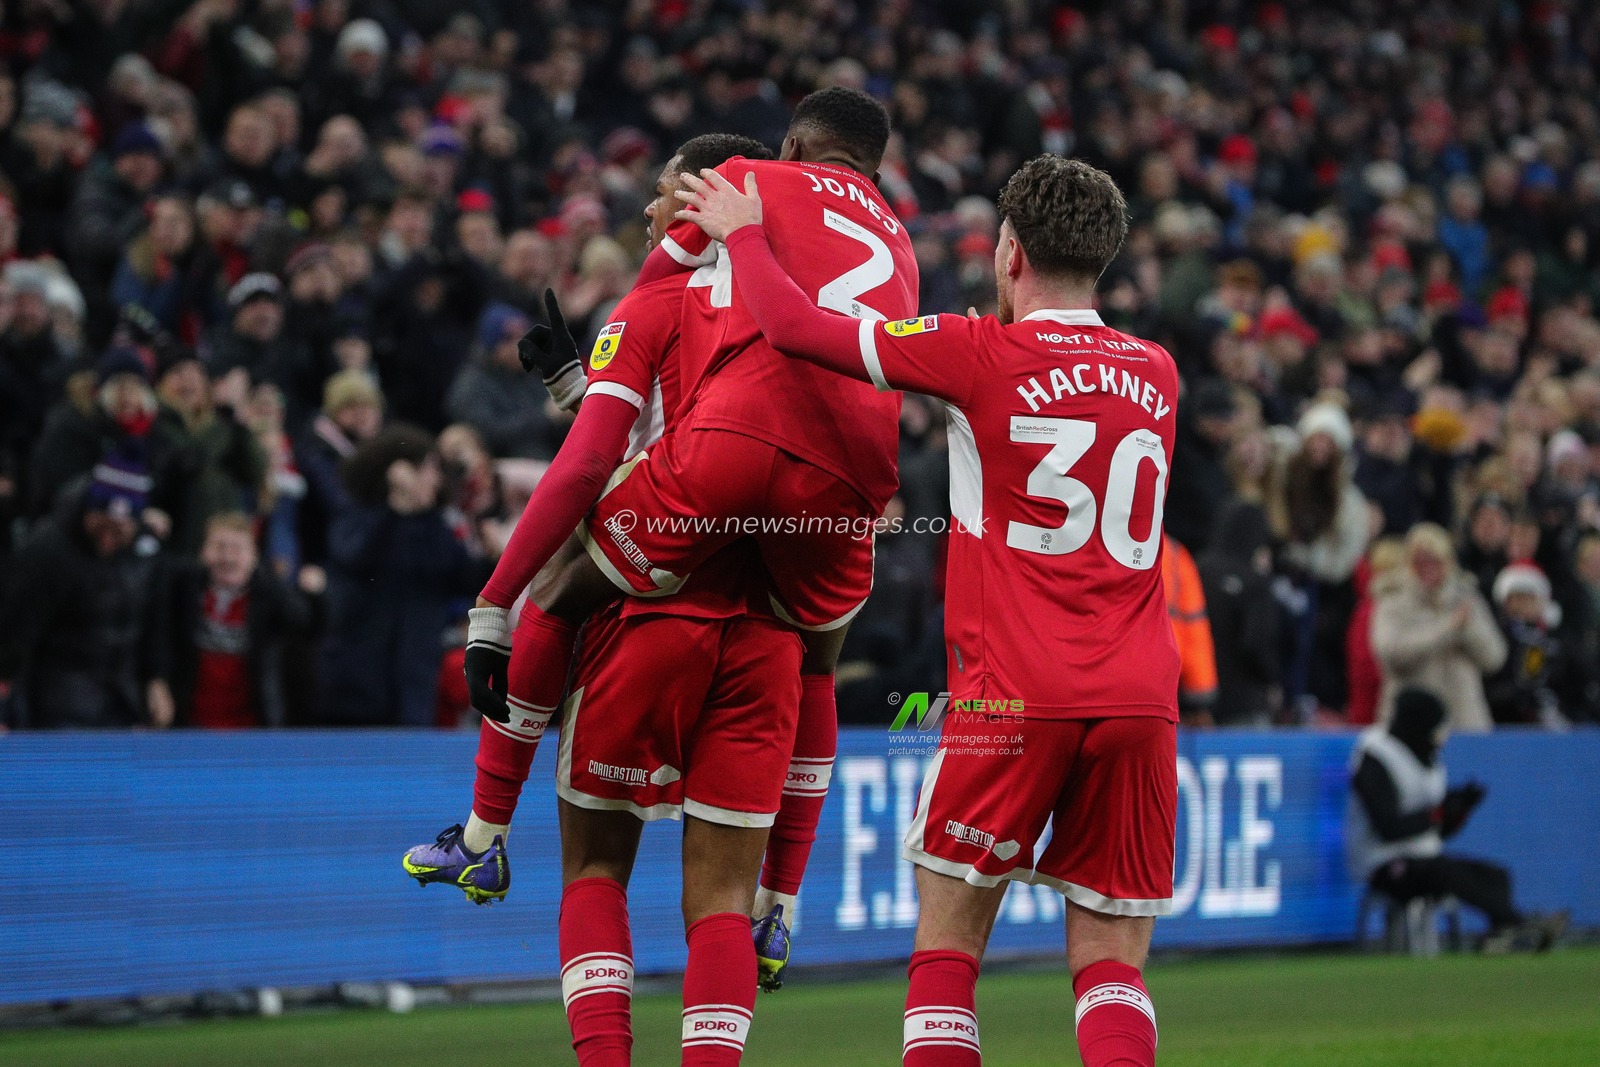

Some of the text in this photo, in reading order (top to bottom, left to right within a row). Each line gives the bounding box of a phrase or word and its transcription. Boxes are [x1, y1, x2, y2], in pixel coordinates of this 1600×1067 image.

[818, 208, 894, 320] 2
[1016, 363, 1170, 420] HACKNEY
[1006, 415, 1168, 570] 30
[603, 516, 653, 572] CORNERSTONE
[521, 718, 549, 731] BOR
[588, 760, 649, 783] CORNERSTONE
[785, 772, 818, 783] ORO
[585, 967, 628, 980] BORO
[1087, 989, 1142, 1003] BORO
[694, 1020, 738, 1033] BORO
[925, 1020, 976, 1036] BORO
